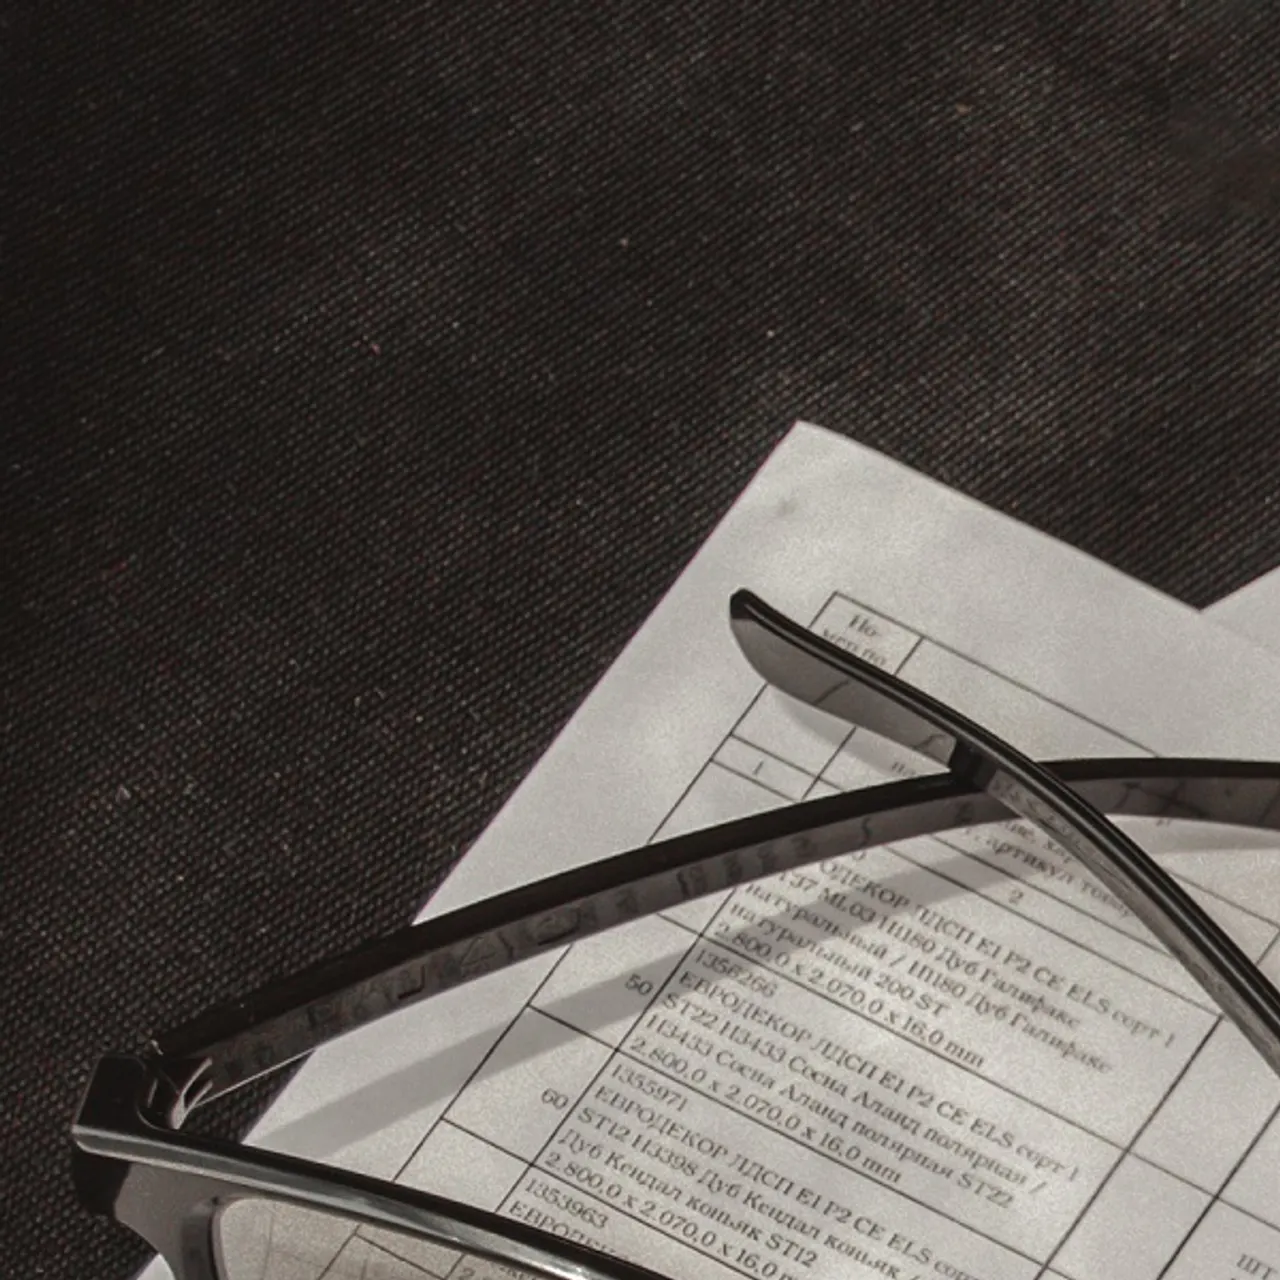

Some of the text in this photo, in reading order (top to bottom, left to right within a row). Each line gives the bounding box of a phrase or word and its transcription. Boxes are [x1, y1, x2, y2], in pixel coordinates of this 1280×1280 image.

[539, 1086, 569, 1110] 60
[610, 1063, 688, 1113] 1355971
[556, 1127, 604, 1160] Дуб
[763, 1232, 819, 1269] ST12
